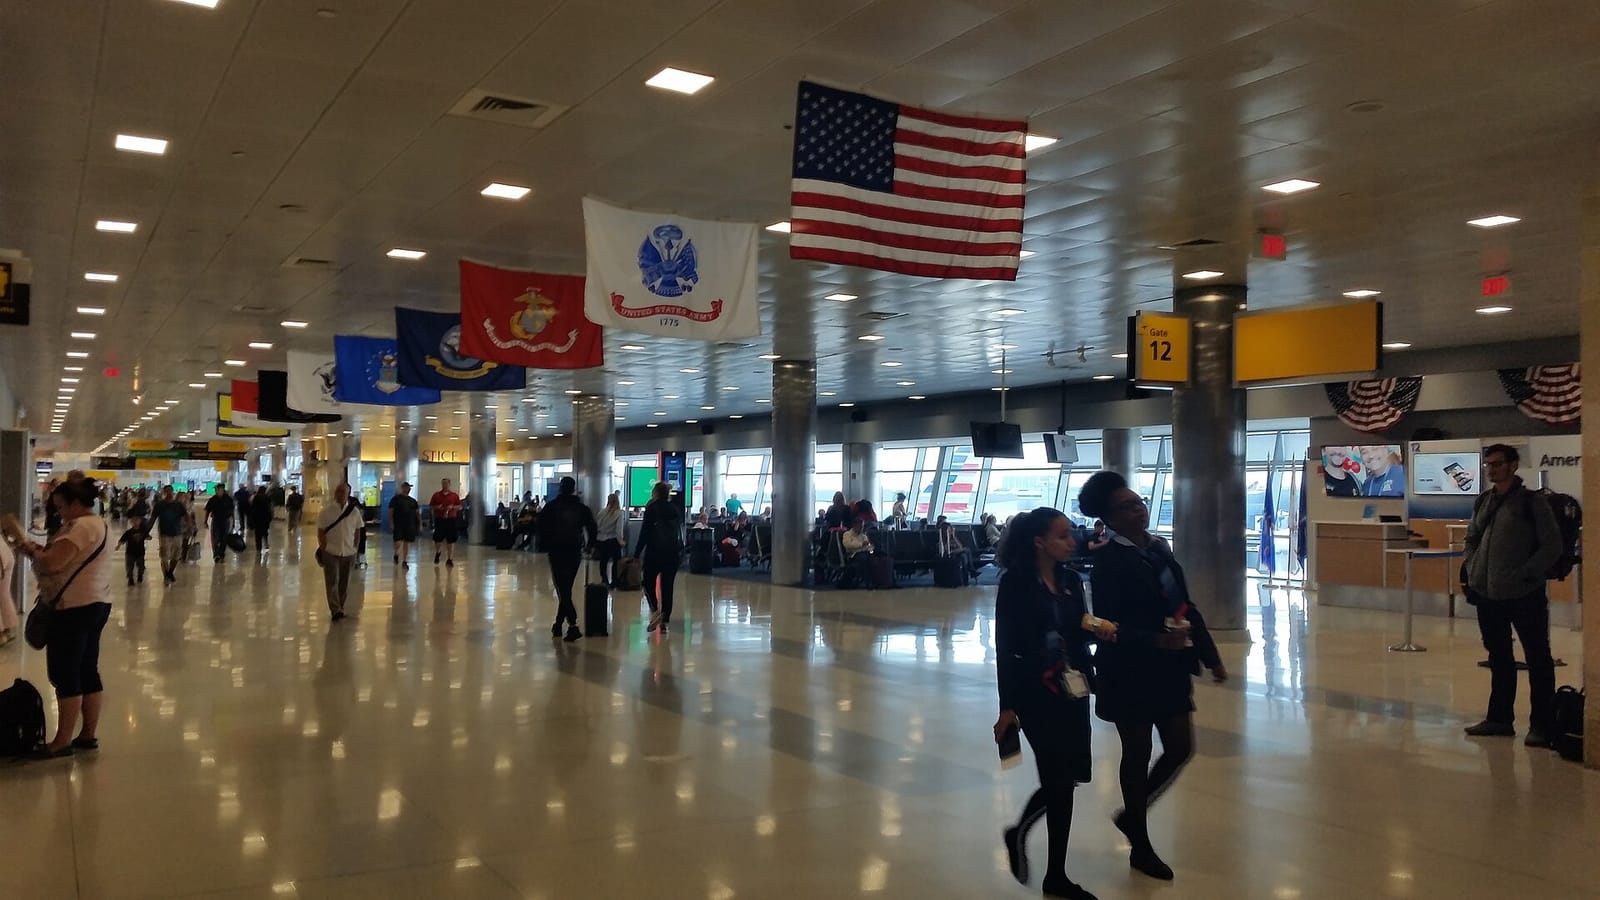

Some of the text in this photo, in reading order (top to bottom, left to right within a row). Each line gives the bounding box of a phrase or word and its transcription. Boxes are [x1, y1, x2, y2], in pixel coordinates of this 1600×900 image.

[1482, 276, 1505, 296] EXIT
[620, 305, 715, 322] UNITED STATES ARMY
[659, 318, 680, 328] 1775
[1149, 328, 1168, 337] Gate
[1150, 340, 1172, 361] 12
[1539, 454, 1582, 467] Amer
